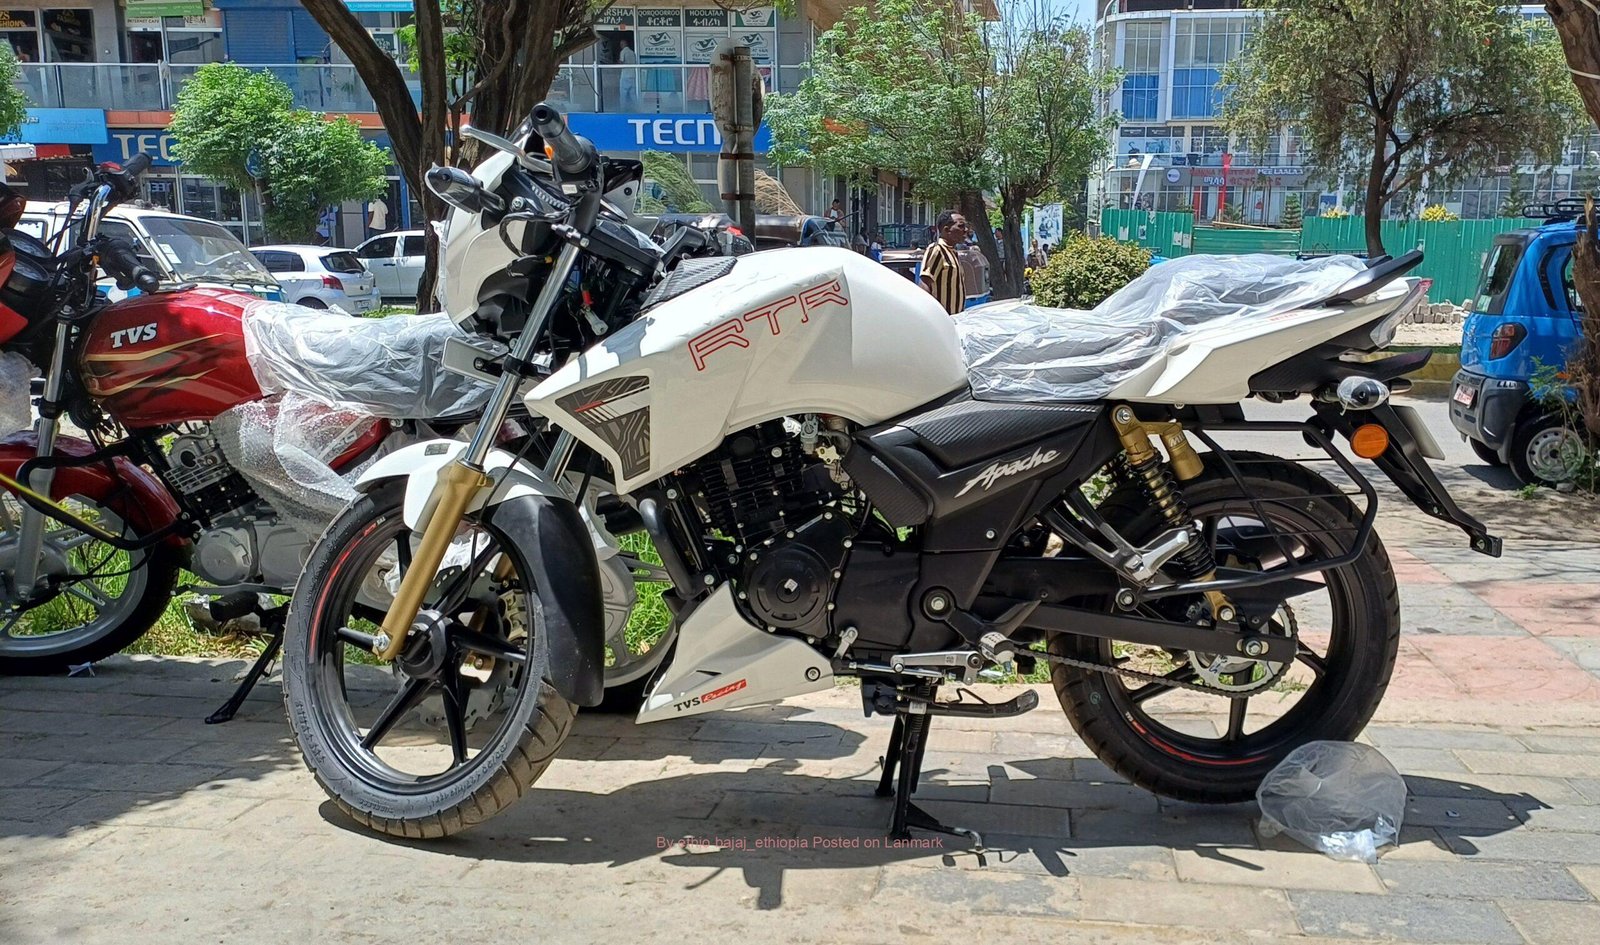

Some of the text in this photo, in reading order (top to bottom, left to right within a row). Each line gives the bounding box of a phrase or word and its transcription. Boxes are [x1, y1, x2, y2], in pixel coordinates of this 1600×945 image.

[593, 9, 634, 17] WRSHAA
[110, 323, 158, 349] TVS
[688, 279, 848, 371] RTR
[953, 446, 1062, 499] Apache
[674, 680, 747, 712] TVS Racing
